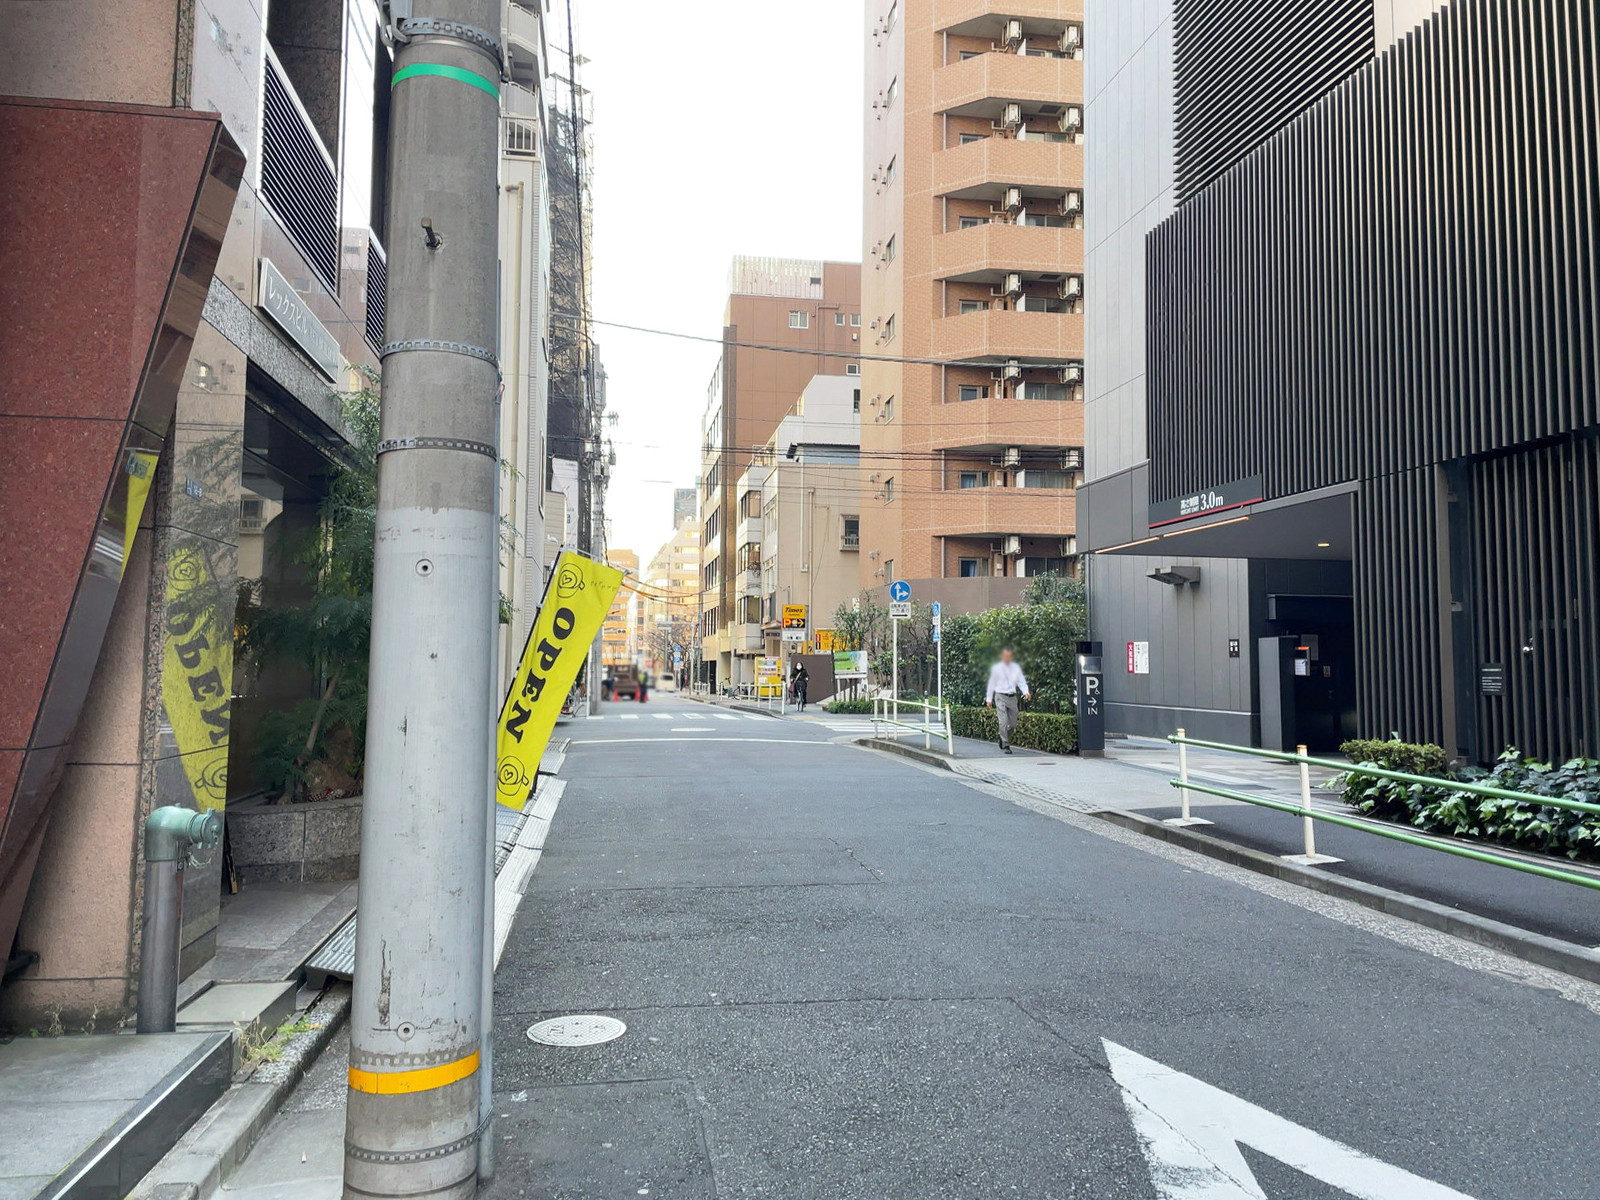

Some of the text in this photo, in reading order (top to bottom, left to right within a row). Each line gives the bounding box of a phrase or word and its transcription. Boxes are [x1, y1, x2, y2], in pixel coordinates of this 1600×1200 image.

[1200, 491, 1224, 510] 3.0m
[505, 607, 575, 744] OPEN
[1086, 677, 1099, 695] P
